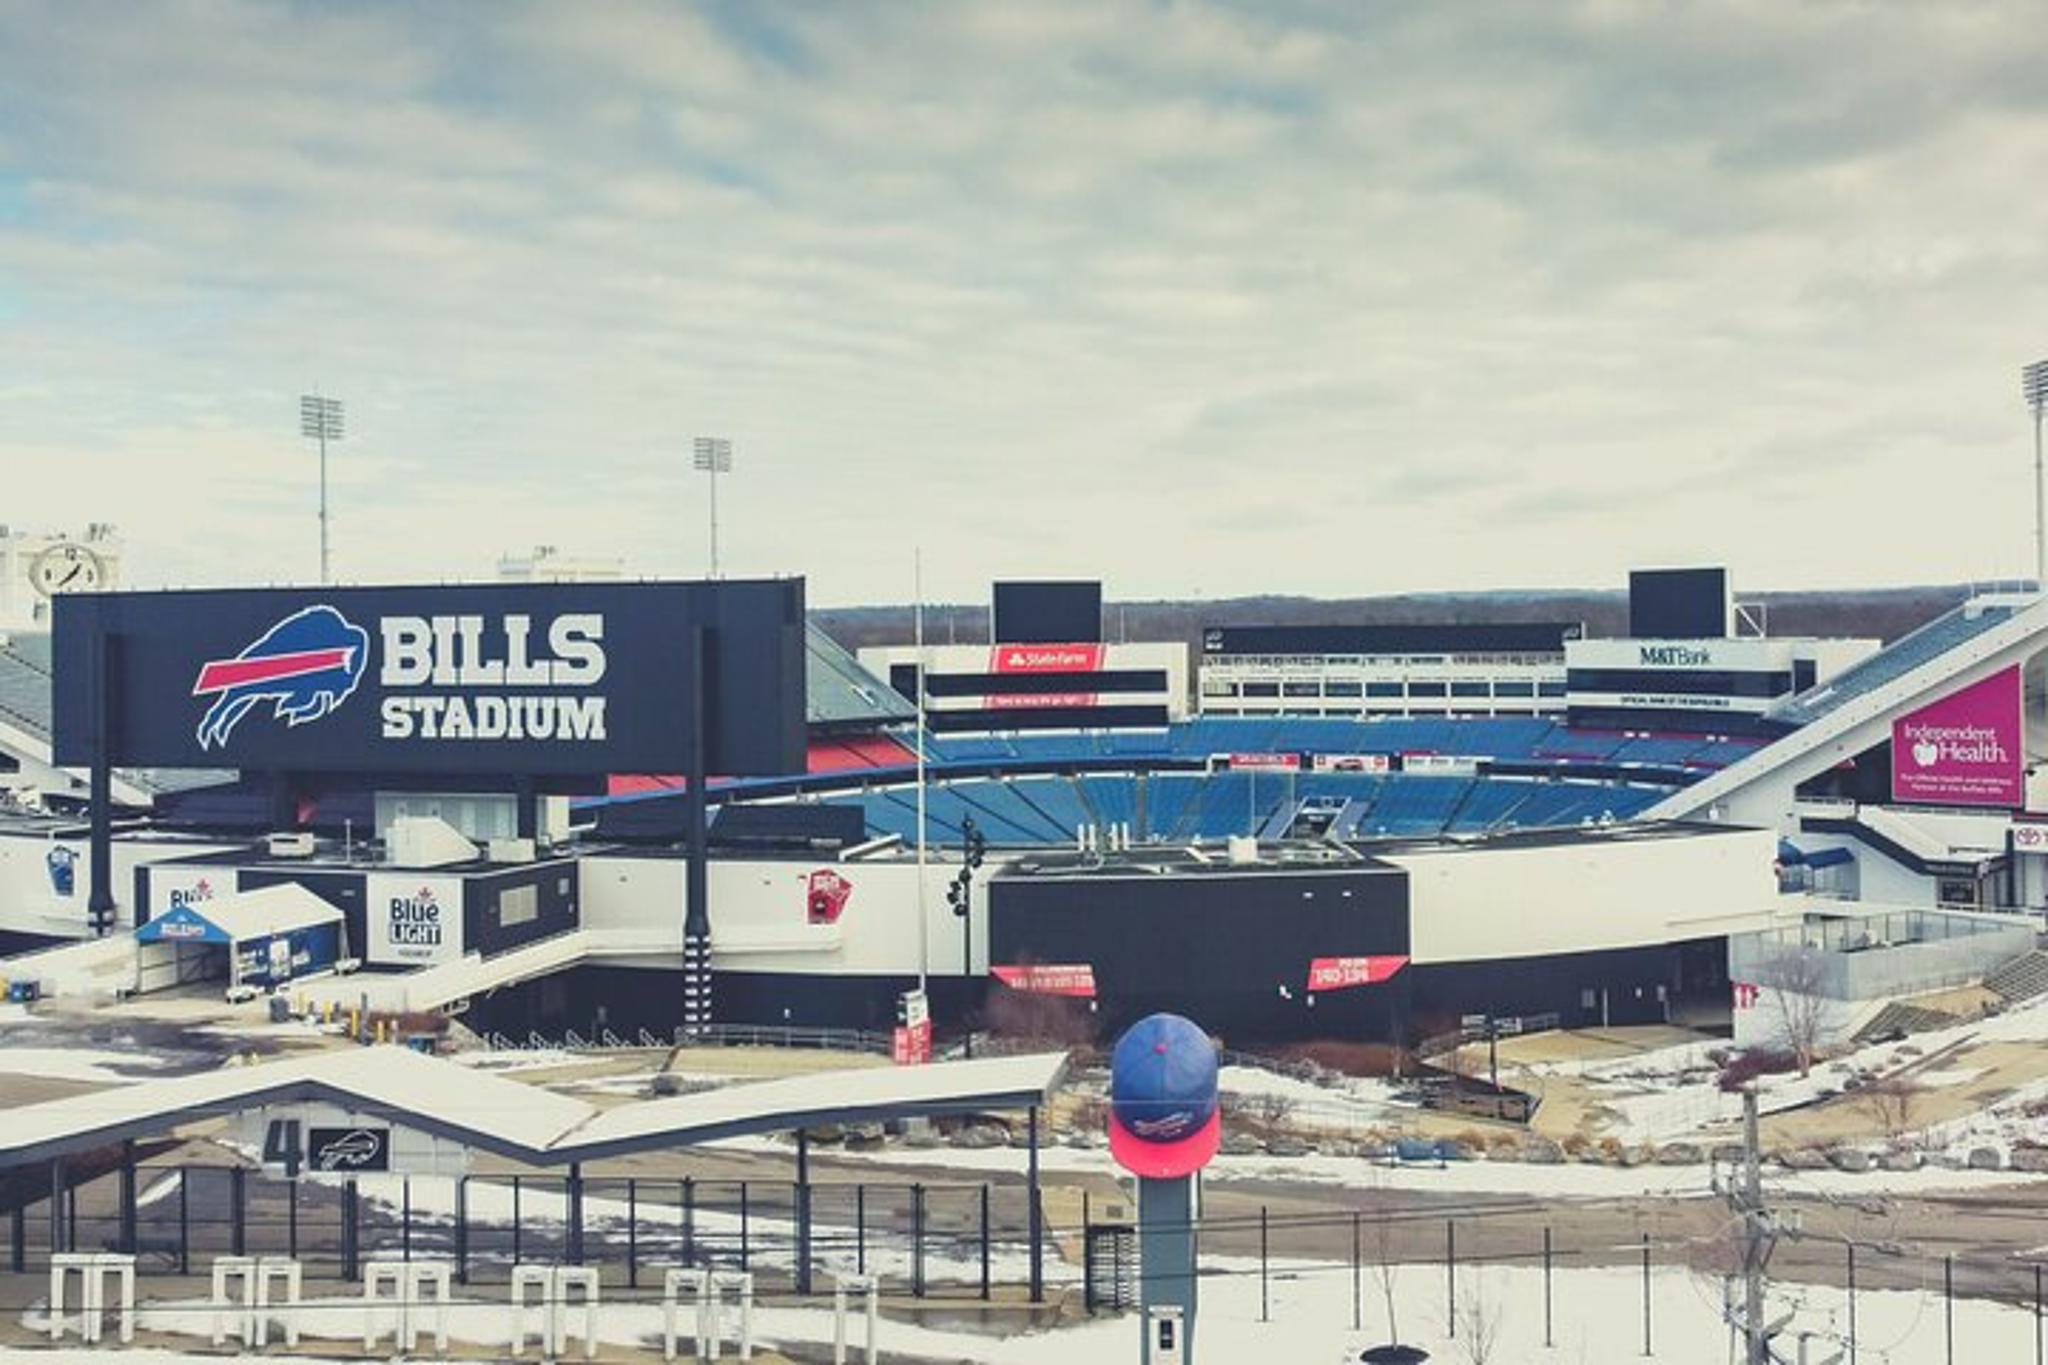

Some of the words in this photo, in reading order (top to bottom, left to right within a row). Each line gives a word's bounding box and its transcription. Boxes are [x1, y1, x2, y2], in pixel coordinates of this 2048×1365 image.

[380, 613, 607, 686] BILLS
[380, 694, 607, 740] STADIUM
[1904, 723, 1996, 741] Independent
[391, 898, 439, 922] Blue
[392, 924, 440, 943] LIGHT
[263, 1120, 304, 1178] 4
